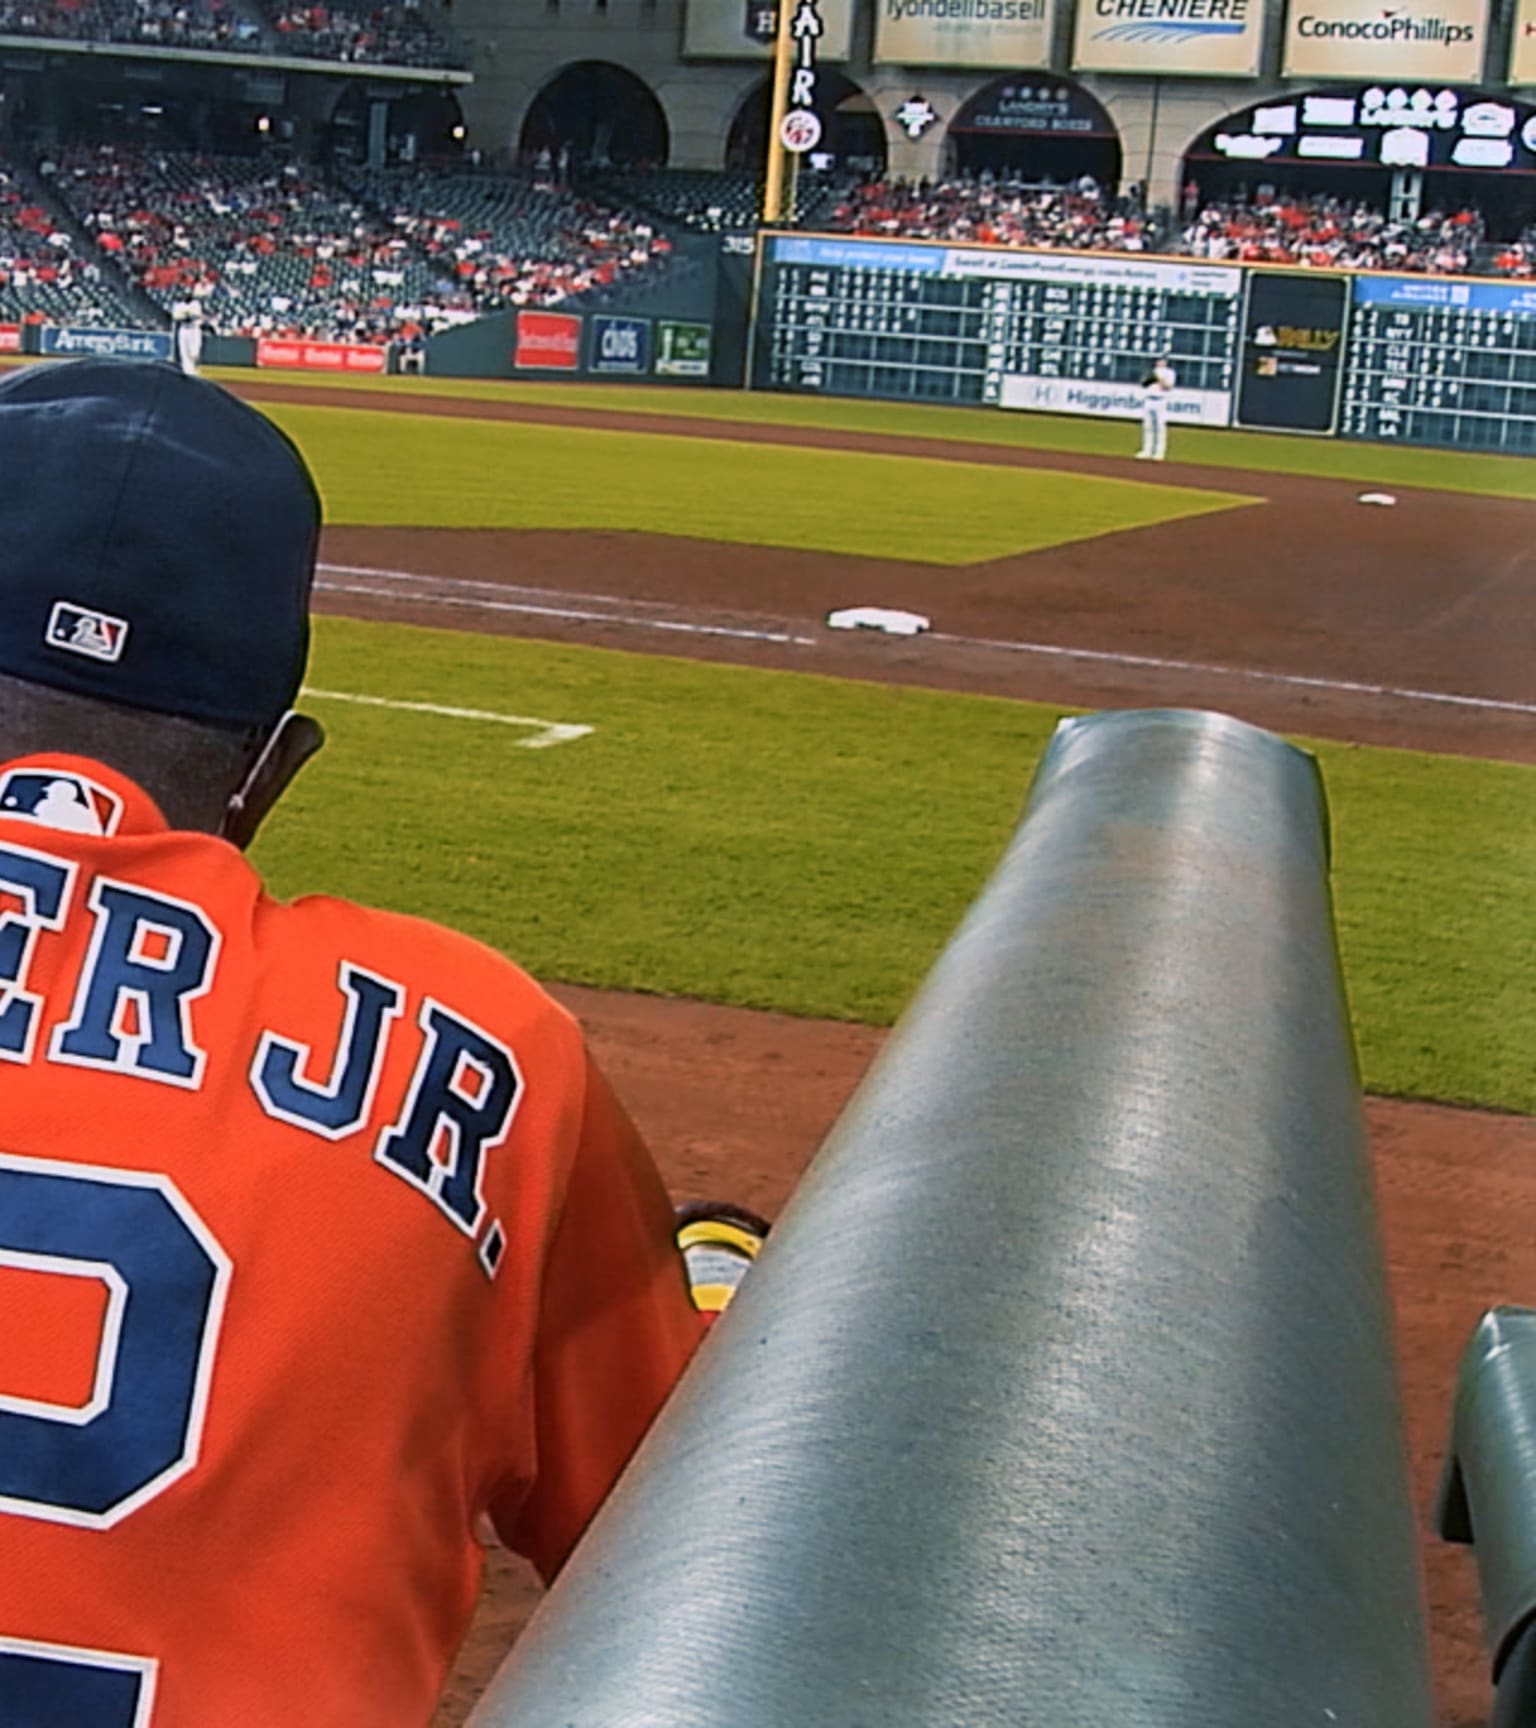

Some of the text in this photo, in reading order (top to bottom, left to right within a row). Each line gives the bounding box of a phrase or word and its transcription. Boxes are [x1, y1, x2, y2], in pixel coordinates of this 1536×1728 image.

[1095, 0, 1248, 20] CHENIERE
[1297, 15, 1475, 47] ConocoPhillips
[721, 236, 755, 254] 315
[248, 960, 526, 1280] JR.
